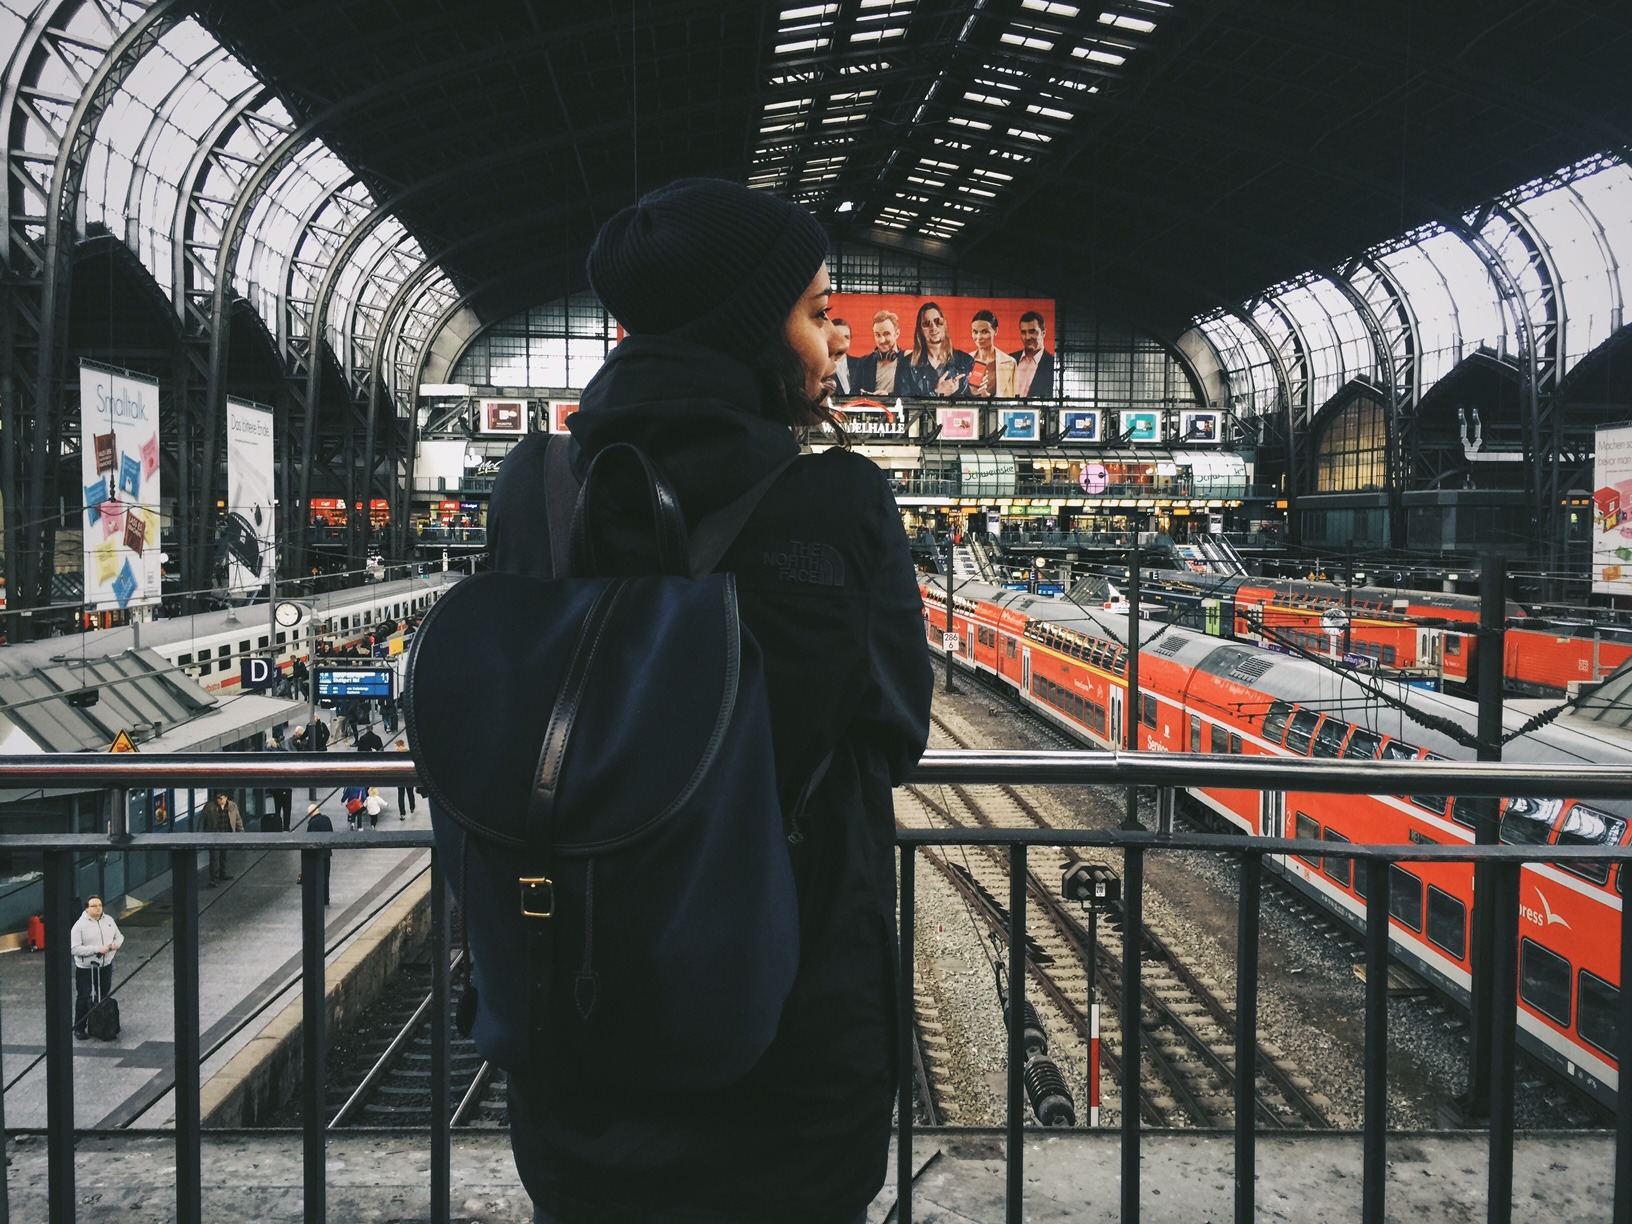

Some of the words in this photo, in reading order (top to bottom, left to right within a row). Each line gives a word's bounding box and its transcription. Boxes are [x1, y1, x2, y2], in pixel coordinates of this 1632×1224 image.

[96, 384, 149, 421] Smalltalk.
[821, 421, 905, 434] WNDELHALLE
[790, 540, 821, 556] THE
[762, 551, 819, 571] NORTH
[778, 567, 818, 584] FACE
[944, 633, 958, 641] 286
[948, 641, 954, 649] 6
[251, 660, 268, 682] D
